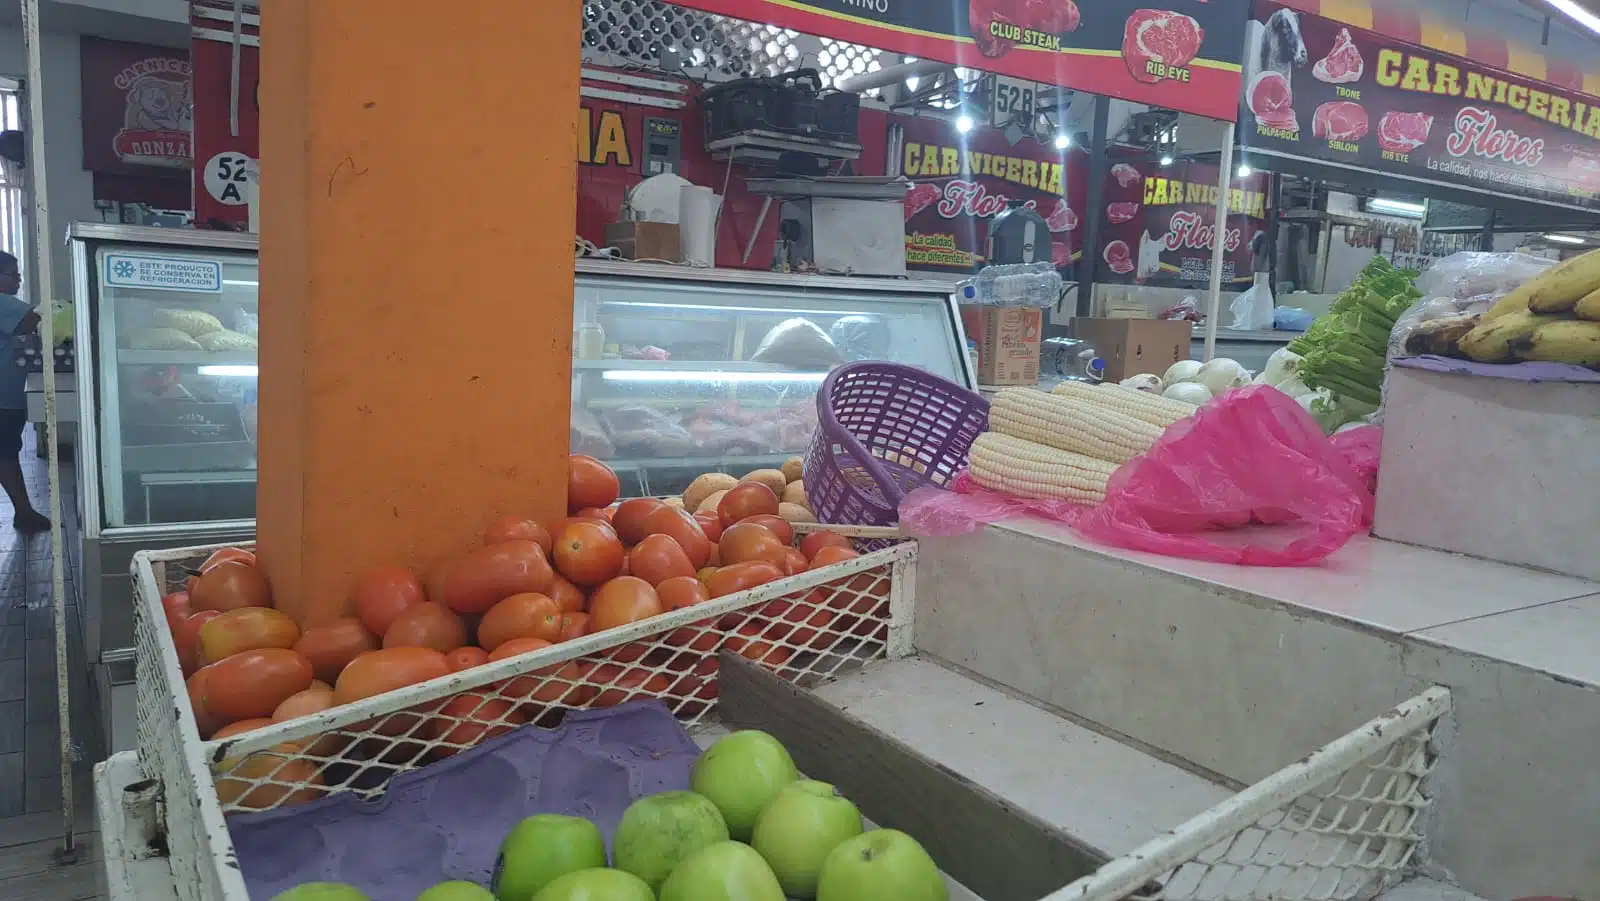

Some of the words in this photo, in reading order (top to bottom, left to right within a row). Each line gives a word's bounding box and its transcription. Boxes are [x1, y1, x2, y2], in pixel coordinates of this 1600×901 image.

[990, 21, 1021, 40] CLUB
[1023, 30, 1061, 49] STEAK
[114, 57, 193, 90] CARNICE
[1146, 60, 1166, 77] RIB
[1167, 65, 1190, 82] EYE
[1336, 86, 1361, 100] TBONE
[1376, 49, 1600, 139] CARNICERIA
[131, 138, 193, 160] GONZA
[1447, 105, 1545, 168] Flores
[217, 156, 248, 182] 52
[904, 142, 1065, 196] CARNICERIA
[1427, 156, 1438, 170] La
[1473, 168, 1489, 180] nos
[220, 182, 241, 202] A
[938, 179, 1037, 219] Flor
[1143, 177, 1265, 220] CARNICRIA
[140, 262, 162, 270] ESTE
[164, 264, 213, 273] PRODUCTO
[154, 270, 201, 279] CONSERVA
[203, 272, 215, 280] EN
